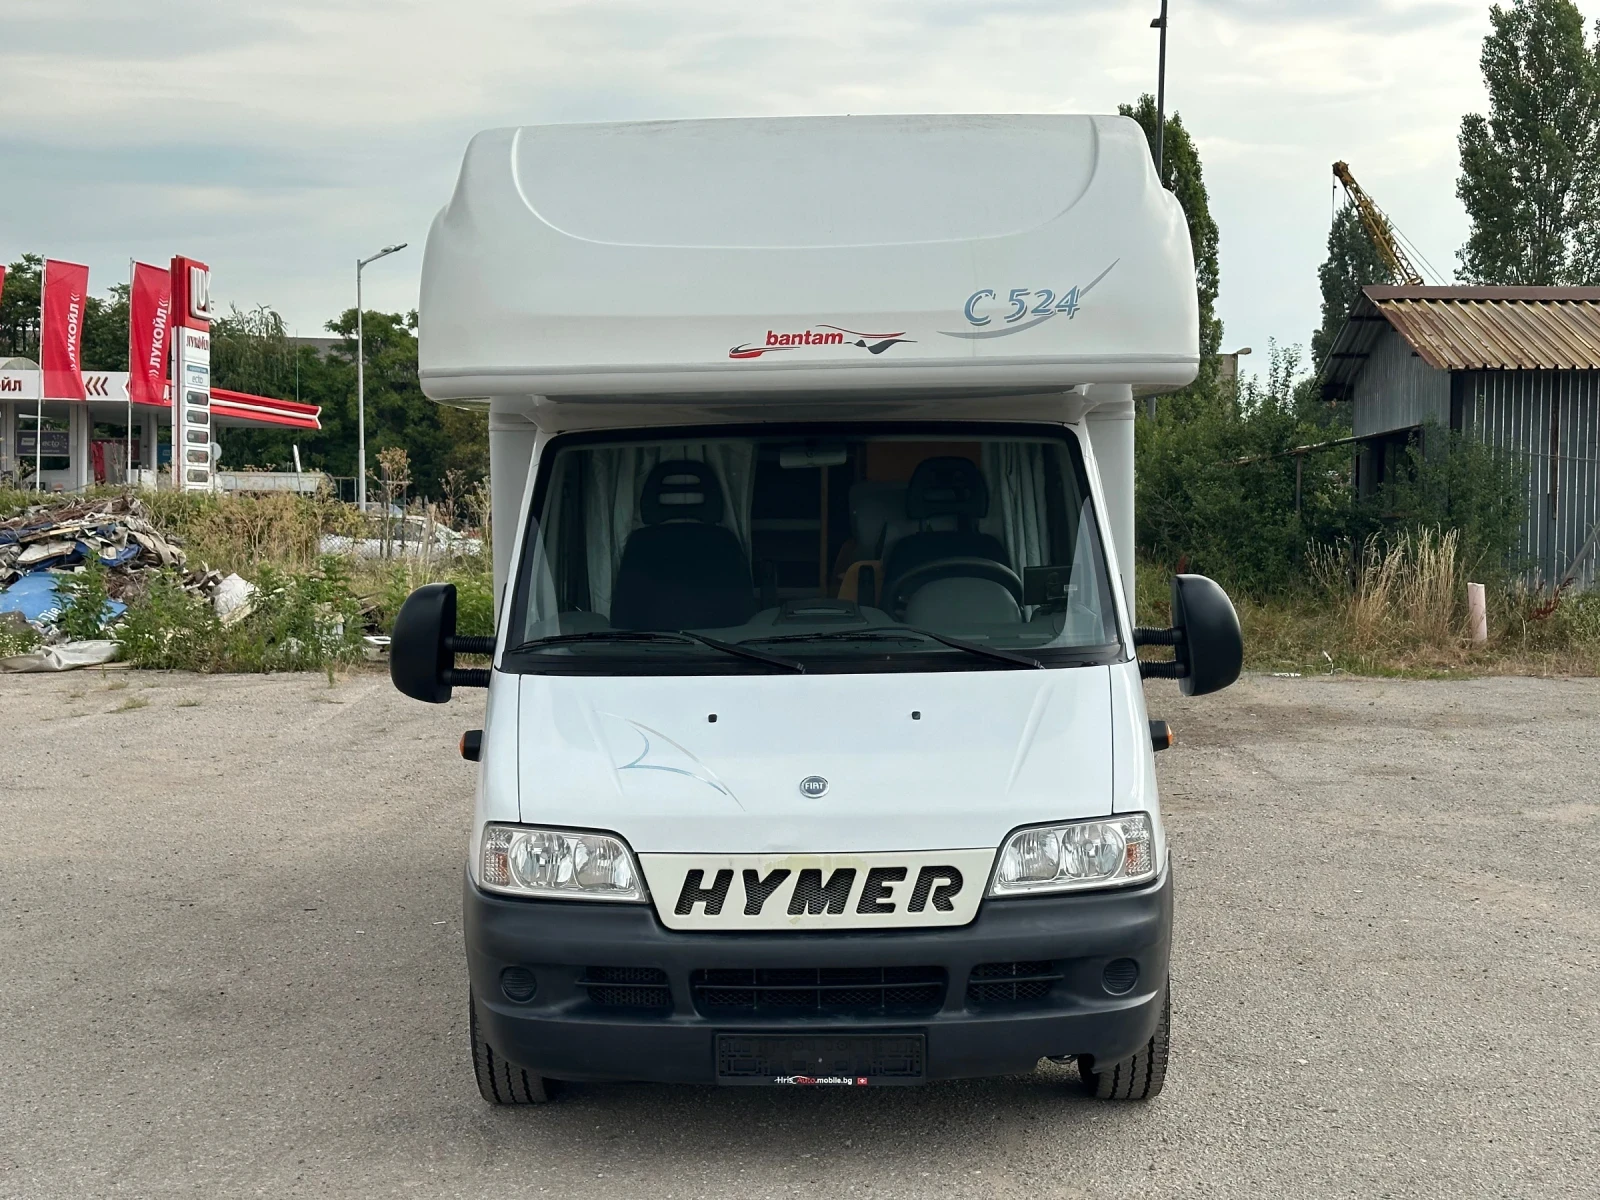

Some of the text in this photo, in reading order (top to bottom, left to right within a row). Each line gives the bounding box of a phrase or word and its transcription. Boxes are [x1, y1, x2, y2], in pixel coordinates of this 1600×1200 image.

[964, 285, 1081, 326] C 524
[67, 303, 79, 363] ЛУКОЙЛ
[149, 308, 168, 368] ЛУКОЙЛ
[766, 330, 843, 346] bantam
[0, 376, 22, 391] ЙЛ
[805, 781, 824, 790] FIAT
[674, 865, 964, 916] HYMER
